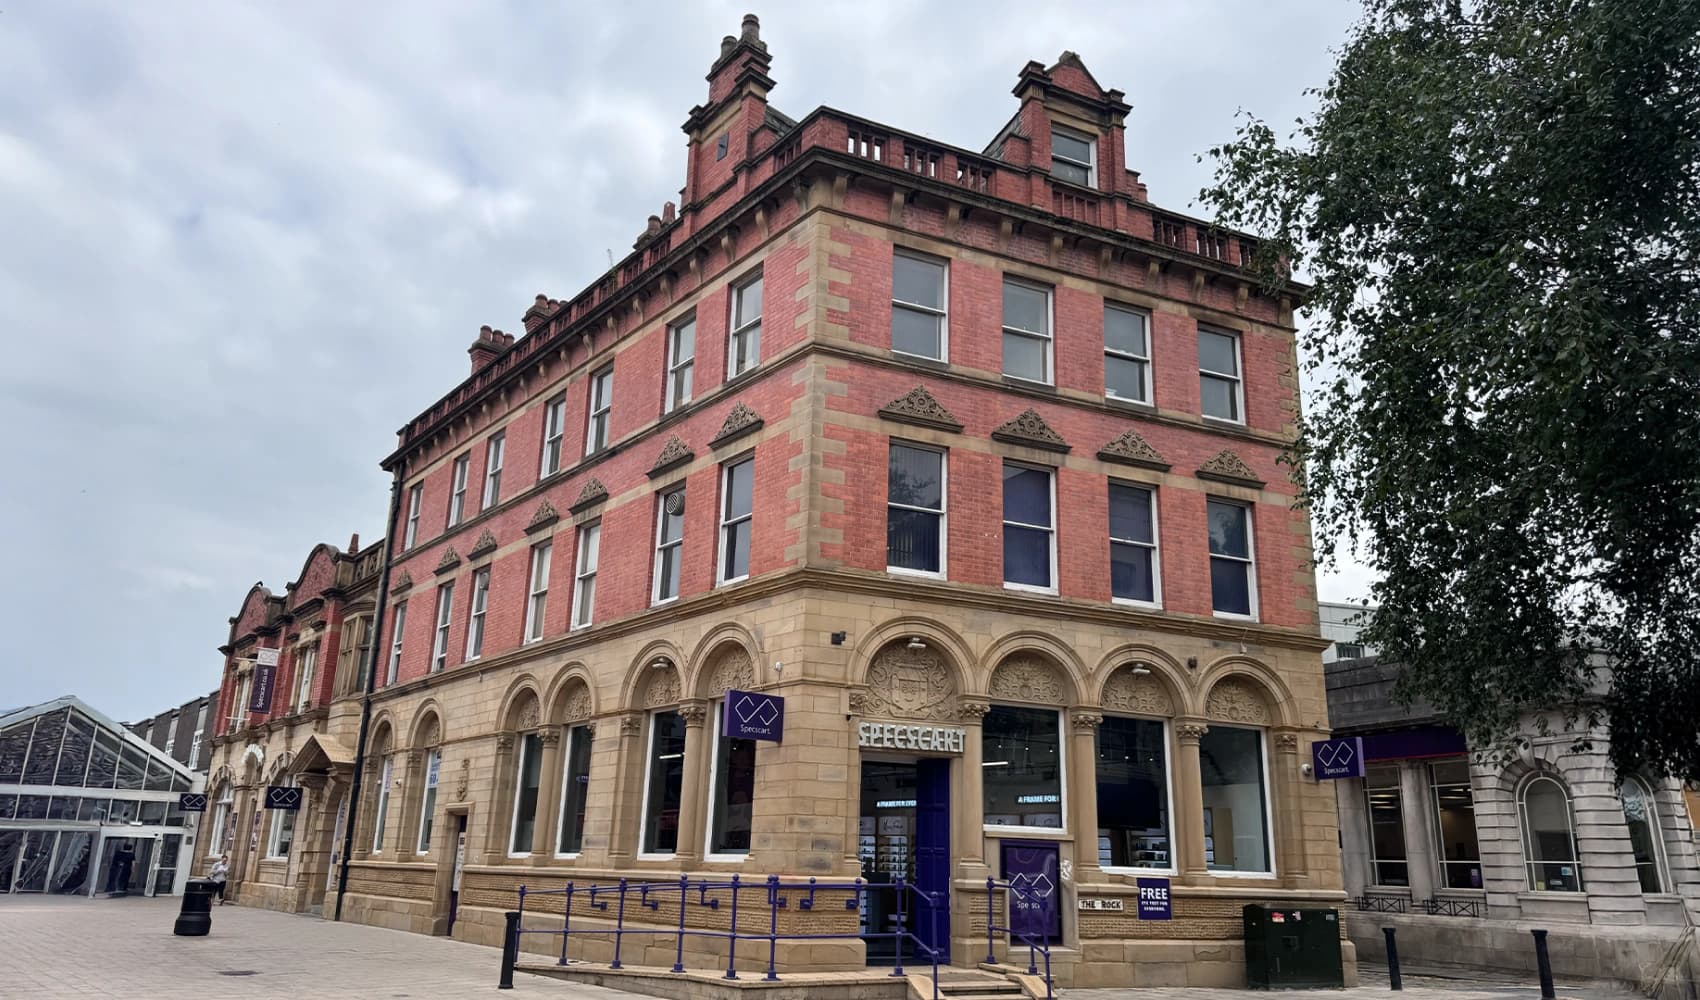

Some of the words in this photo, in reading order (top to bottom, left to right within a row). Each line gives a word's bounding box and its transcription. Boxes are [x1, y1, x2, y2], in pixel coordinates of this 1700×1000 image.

[858, 721, 966, 753] SPECSCART
[1140, 887, 1169, 900] FREE
[1082, 900, 1096, 909] THE
[1101, 900, 1121, 909] ROCK
